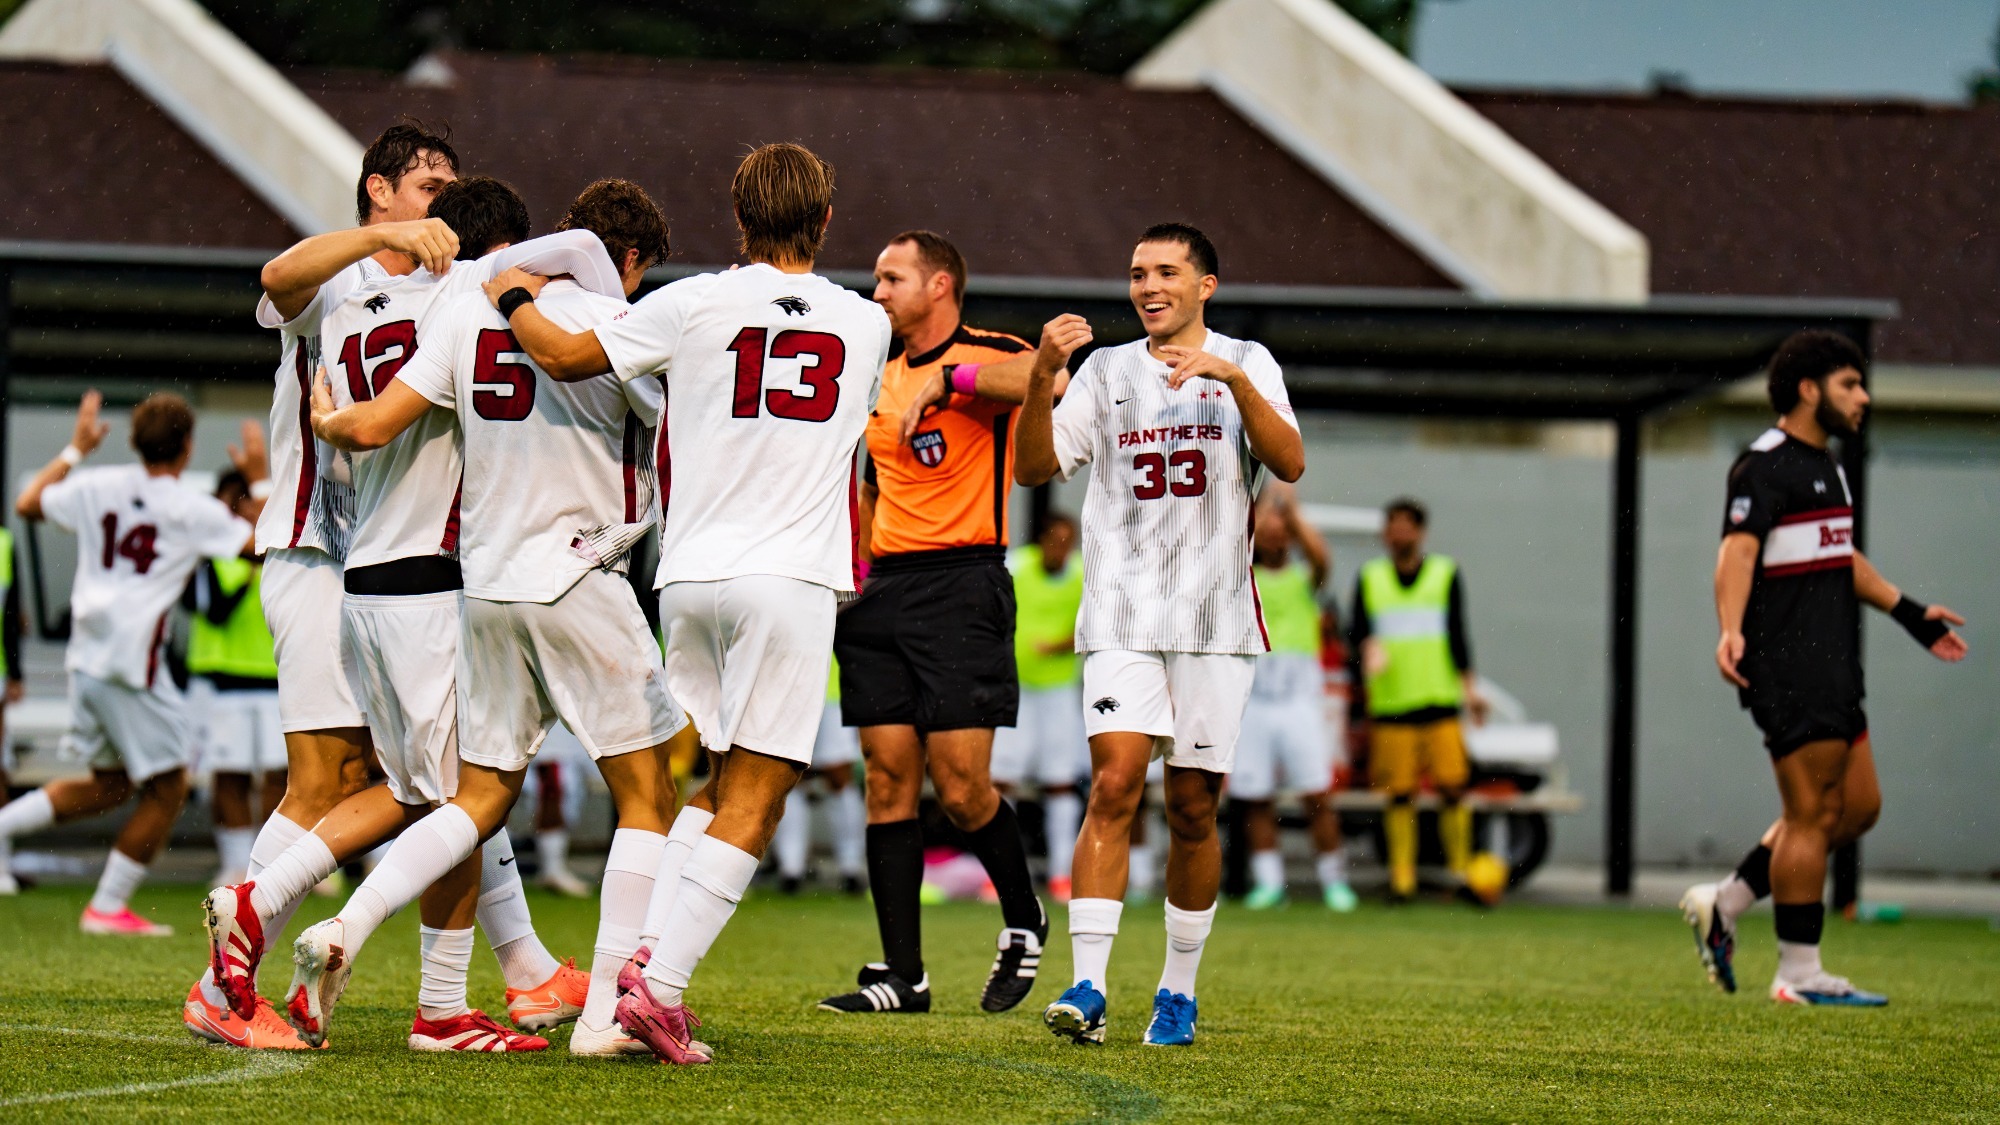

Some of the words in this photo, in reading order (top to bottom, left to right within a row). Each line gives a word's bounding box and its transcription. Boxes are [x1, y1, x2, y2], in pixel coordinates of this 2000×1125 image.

[472, 328, 537, 421] 5
[726, 326, 846, 423] 13
[1118, 424, 1223, 449] PANTHERS
[1133, 449, 1207, 501] 33
[102, 511, 160, 575] 14
